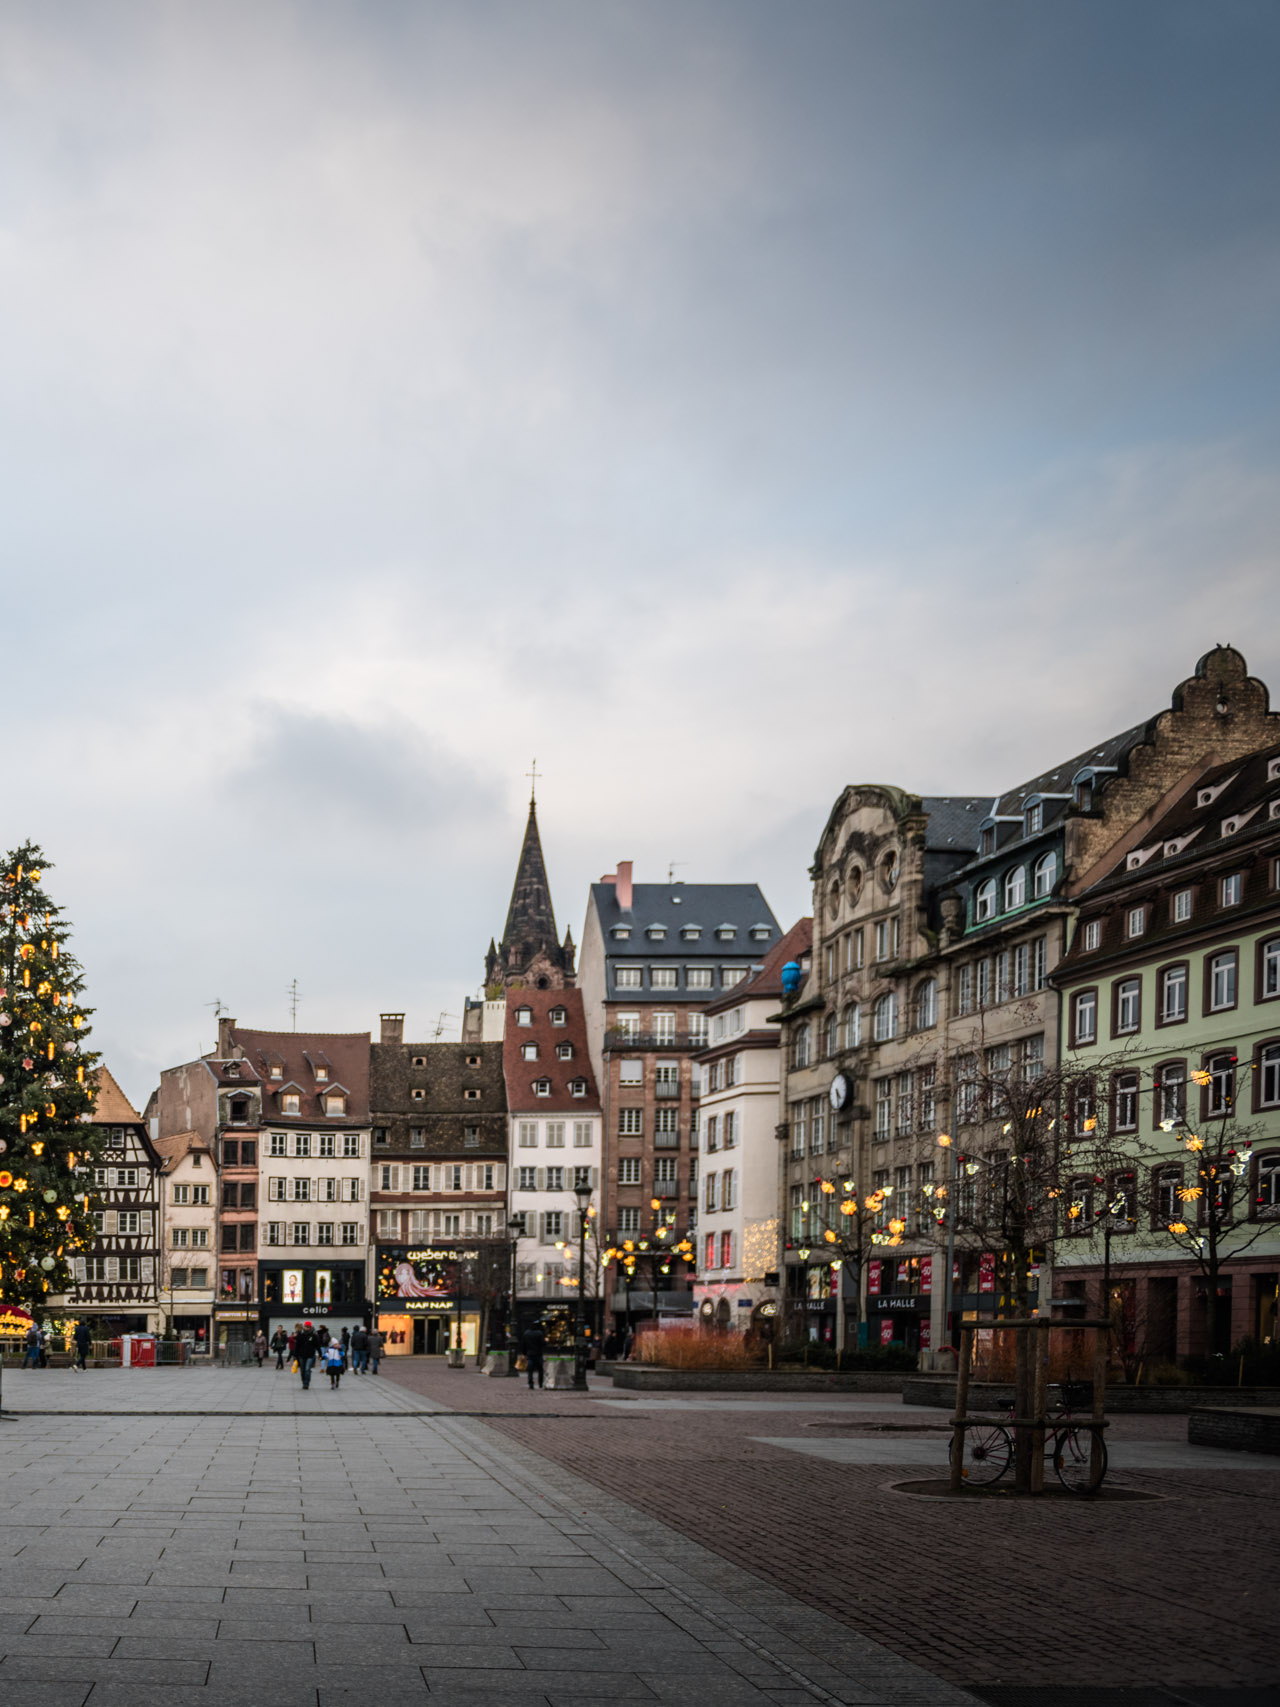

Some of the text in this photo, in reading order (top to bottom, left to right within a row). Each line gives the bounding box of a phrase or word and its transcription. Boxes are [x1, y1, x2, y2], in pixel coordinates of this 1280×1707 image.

[407, 1249, 448, 1260] weber
[793, 1302, 803, 1311] LA
[877, 1298, 916, 1309] LA HALLE
[302, 1305, 329, 1314] celio
